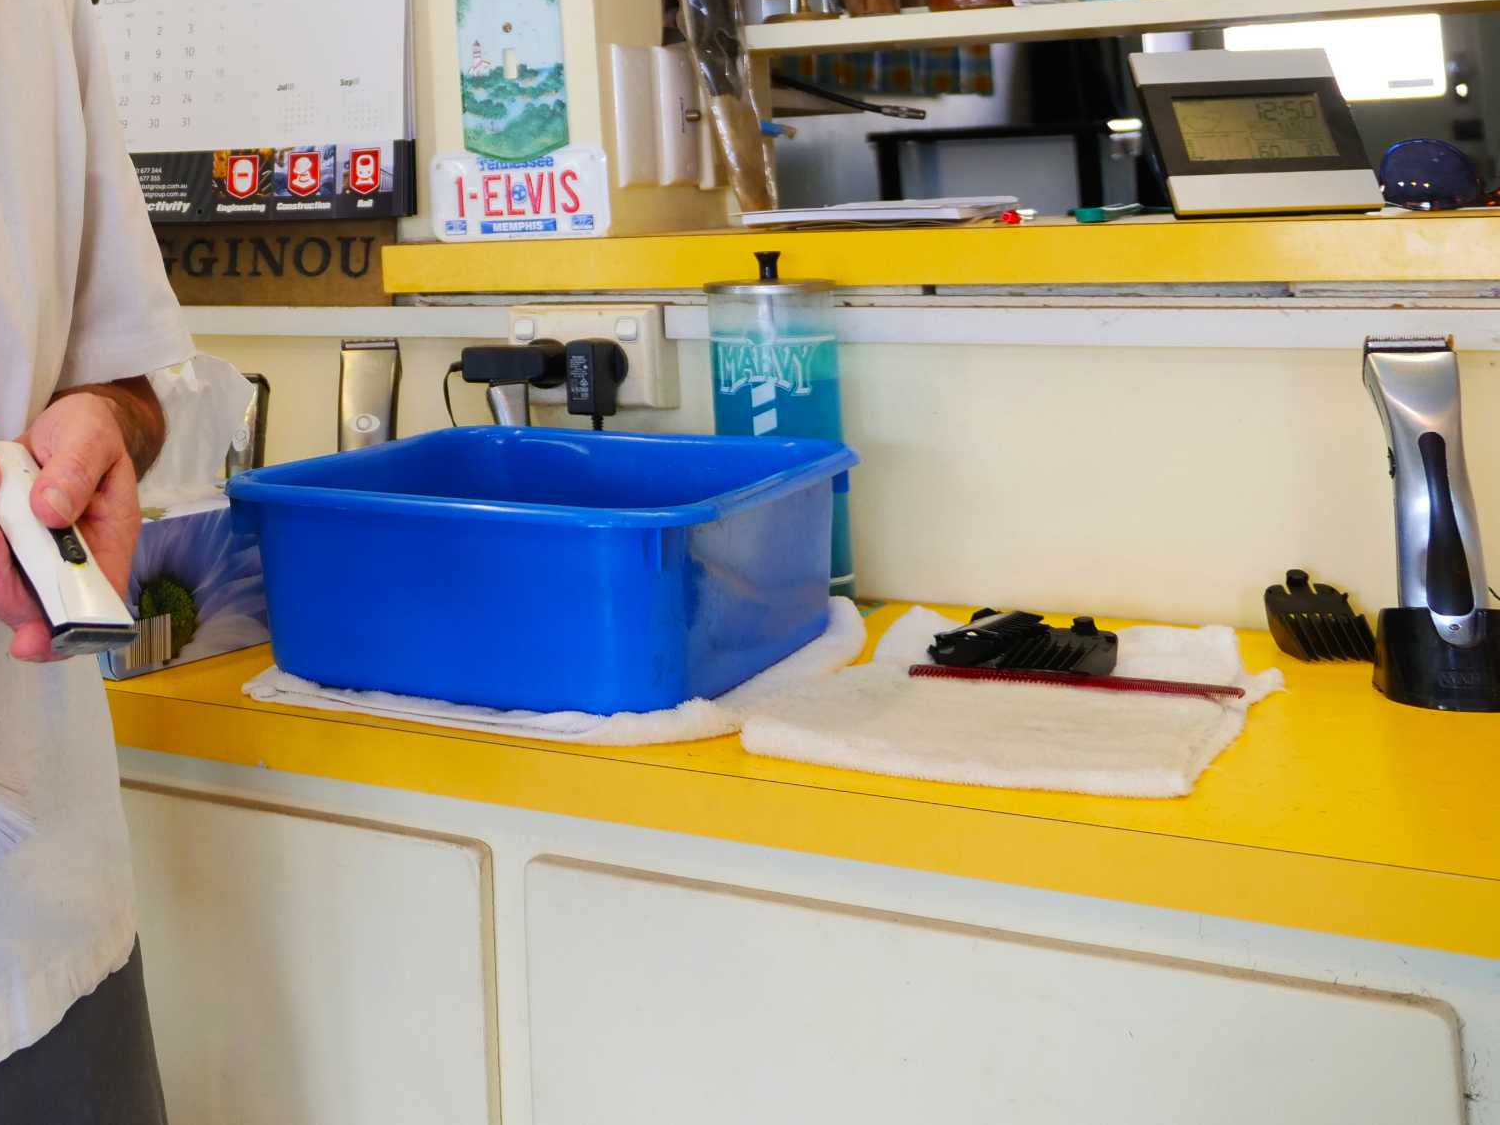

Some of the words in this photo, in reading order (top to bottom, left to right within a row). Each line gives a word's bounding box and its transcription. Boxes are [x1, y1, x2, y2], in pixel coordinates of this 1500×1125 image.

[185, 47, 195, 58] 10
[150, 95, 161, 106] 23
[182, 93, 192, 104] 24
[149, 118, 160, 129] 30
[455, 170, 580, 218] 1-ELVIS
[217, 203, 266, 213] Engineering
[276, 201, 331, 211] Construction
[493, 222, 545, 231] MEMPHIS
